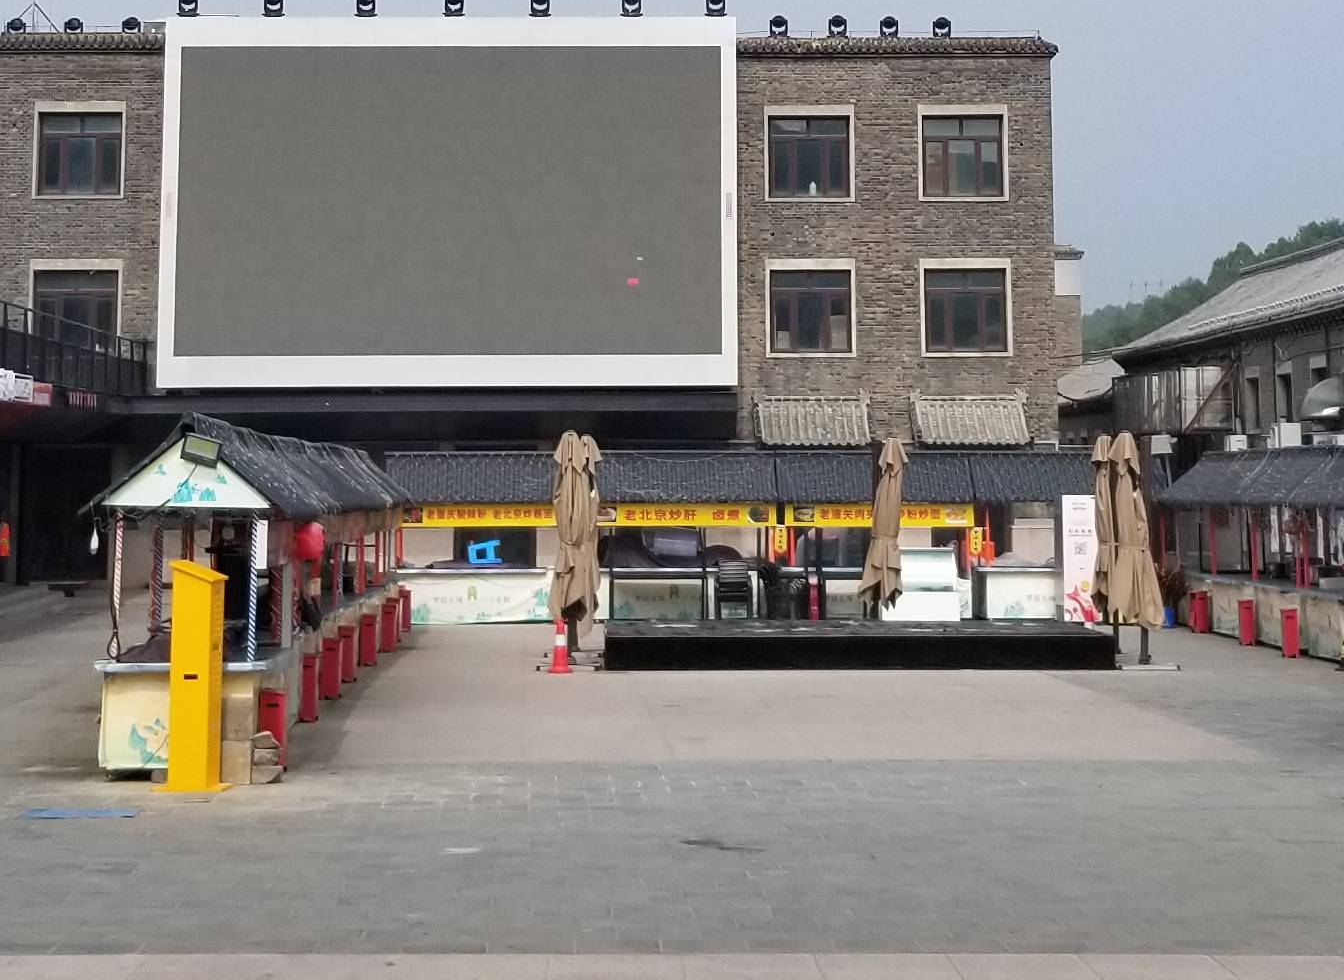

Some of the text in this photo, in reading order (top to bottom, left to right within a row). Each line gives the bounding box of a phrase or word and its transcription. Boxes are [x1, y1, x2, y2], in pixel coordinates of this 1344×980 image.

[623, 508, 740, 521] 老北京炒肝 卤煮
